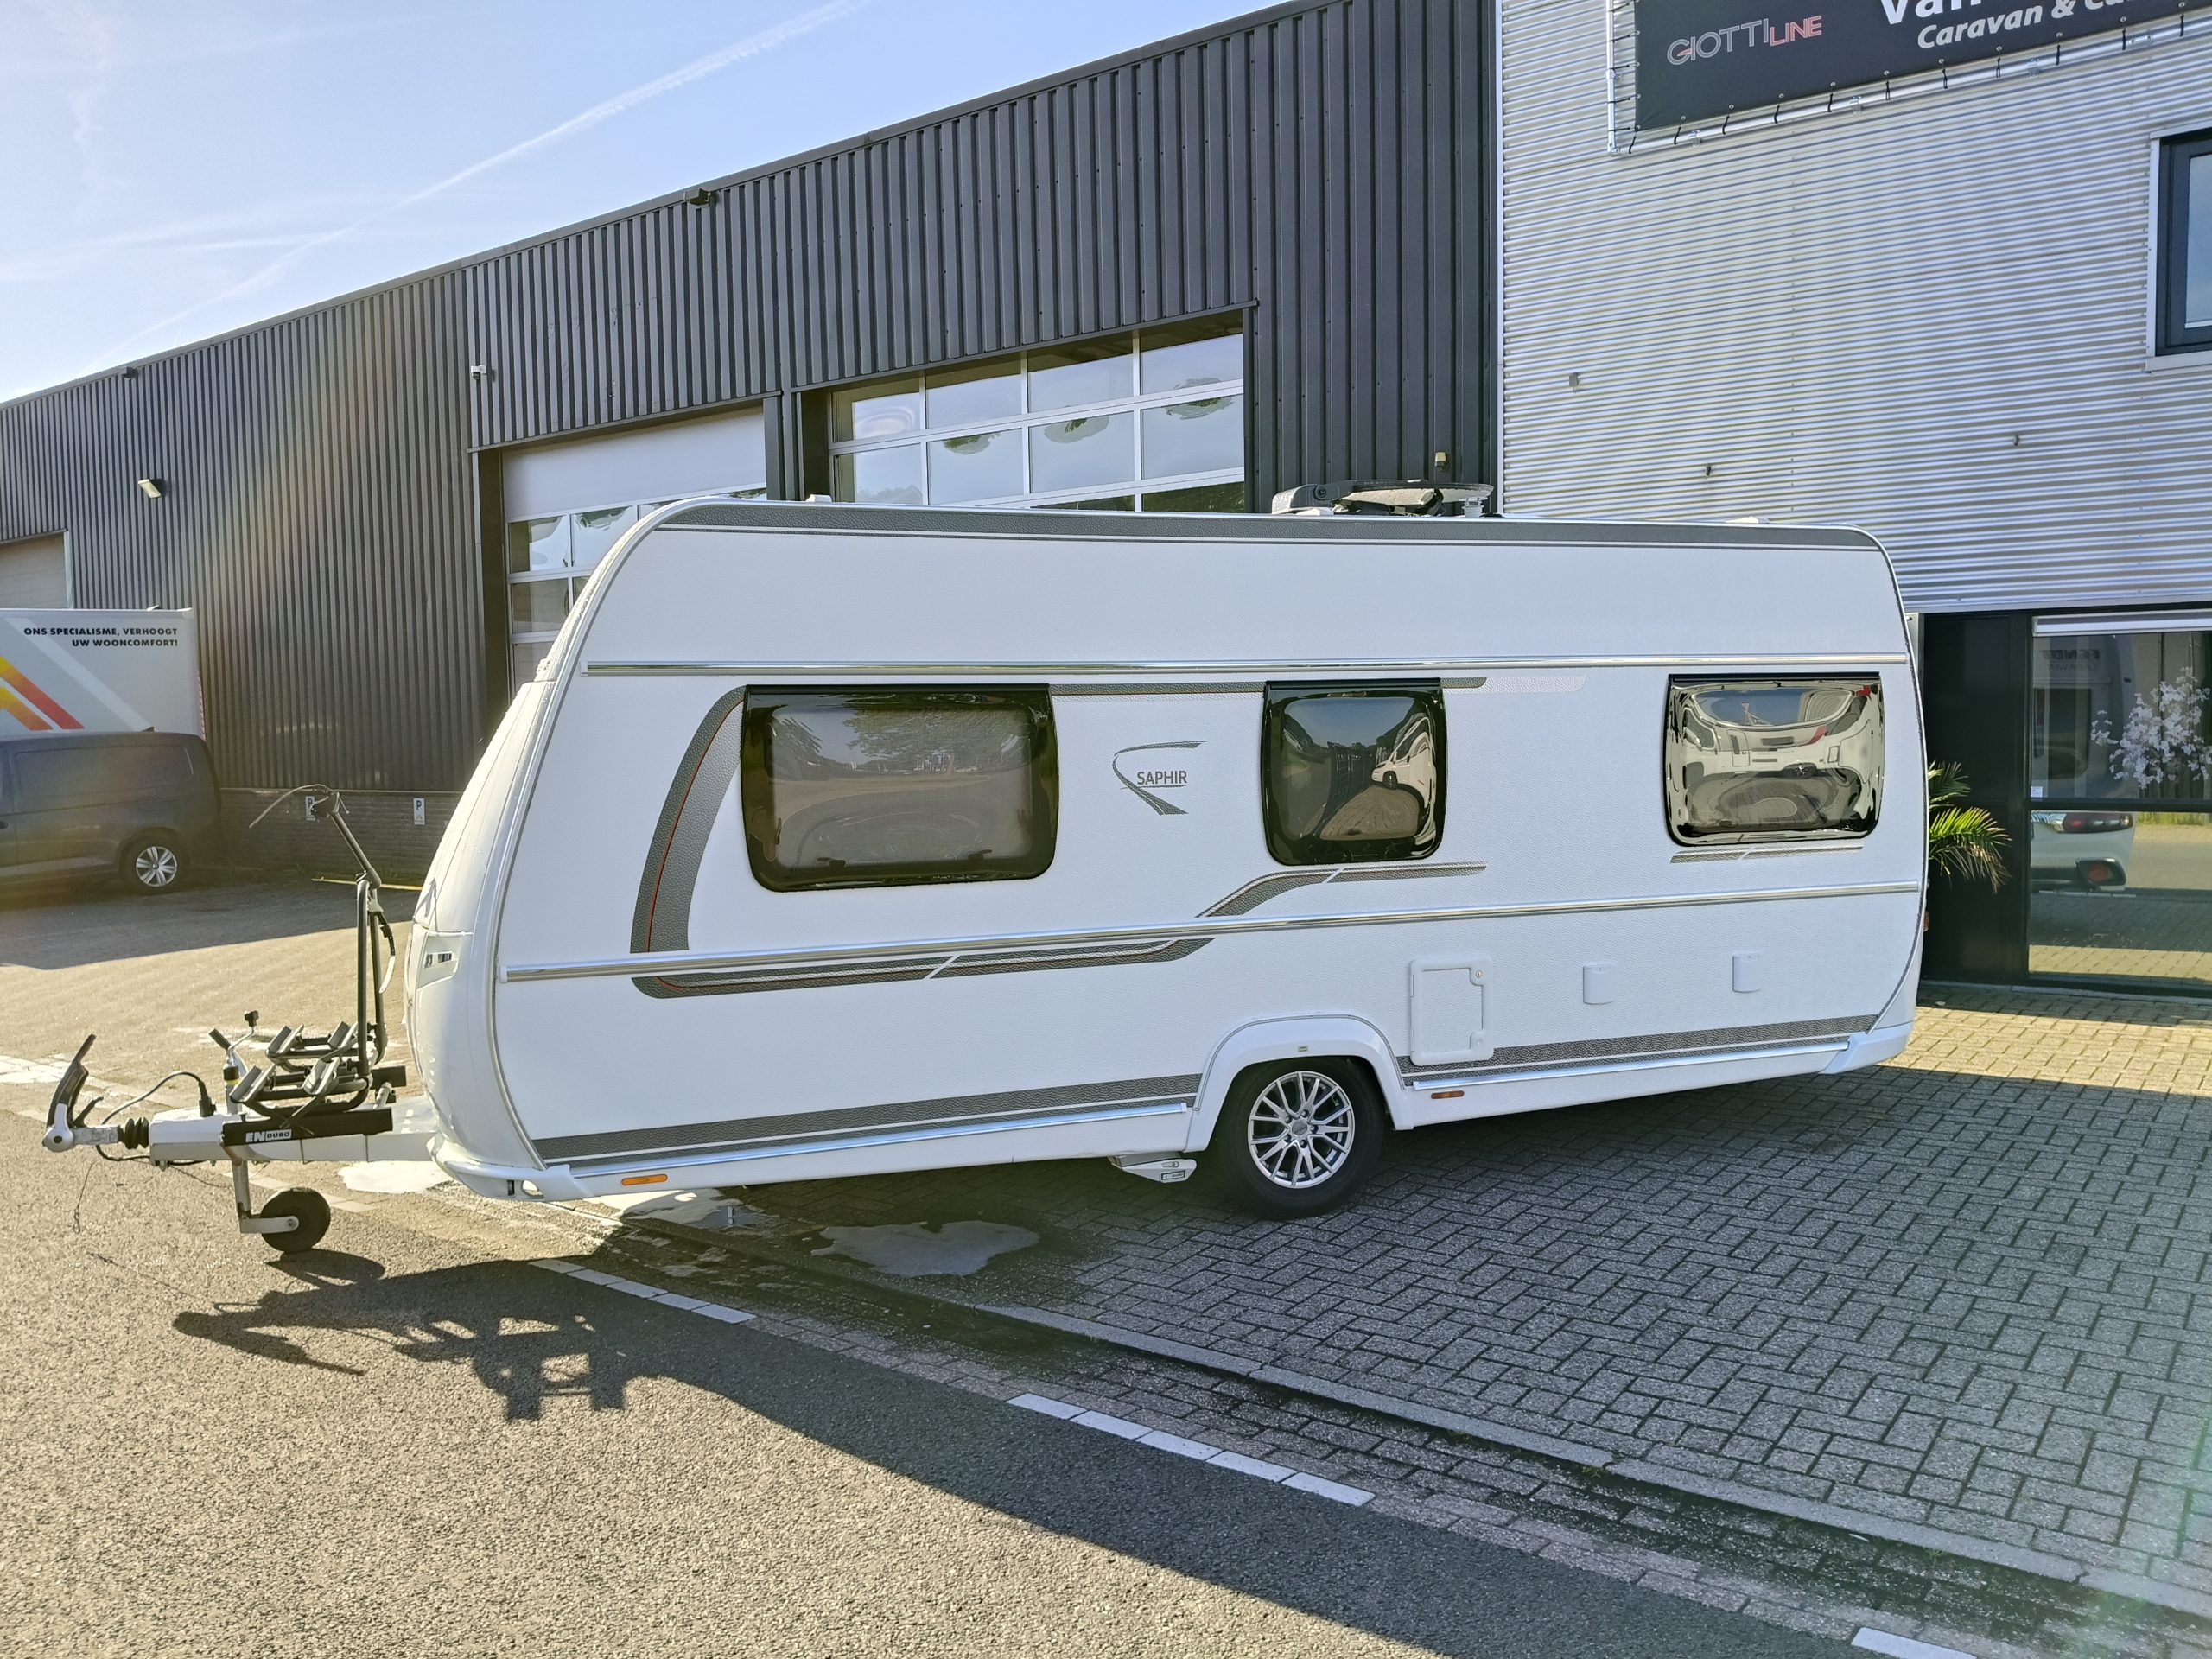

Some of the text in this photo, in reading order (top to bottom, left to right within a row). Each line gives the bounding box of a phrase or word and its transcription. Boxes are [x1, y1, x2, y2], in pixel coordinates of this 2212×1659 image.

[1917, 0, 2074, 49] Caravan &
[50, 627, 120, 637] SPECIALISME,
[1137, 770, 1188, 785] SAPHIR
[416, 800, 423, 810] P
